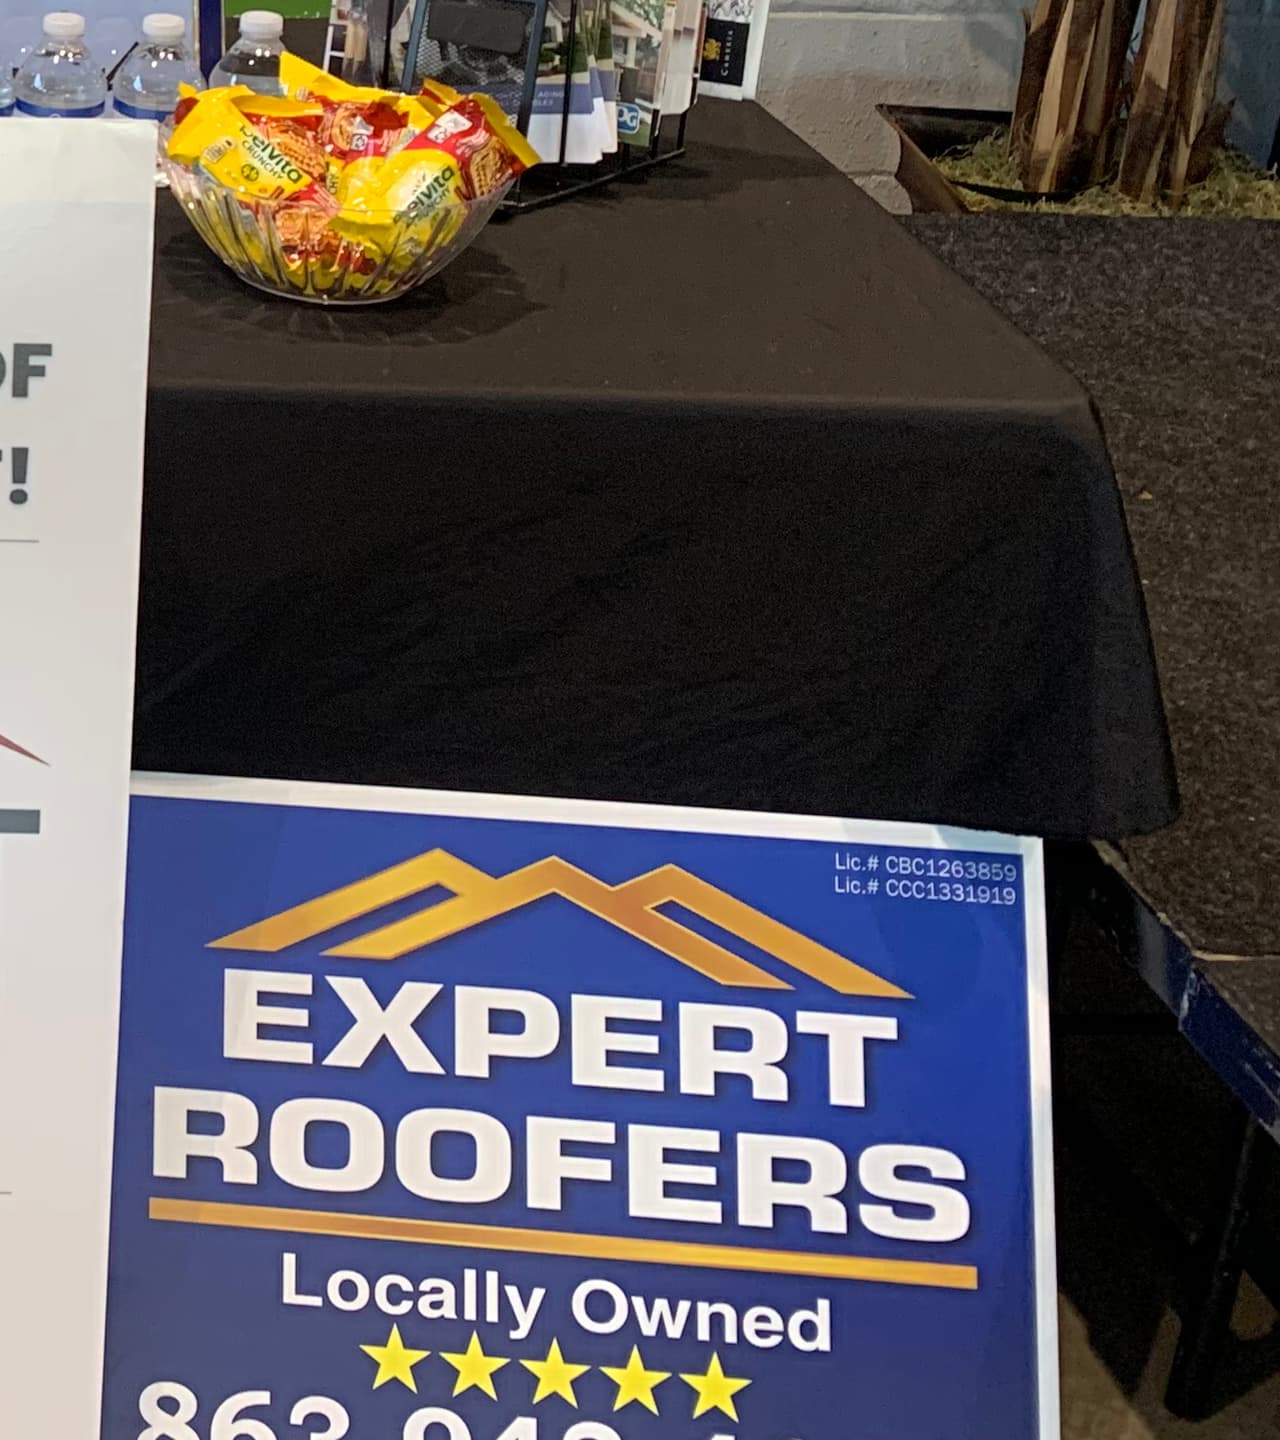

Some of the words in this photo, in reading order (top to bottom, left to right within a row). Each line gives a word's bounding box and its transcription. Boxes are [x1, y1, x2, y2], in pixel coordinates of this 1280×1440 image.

[835, 852, 879, 871] Lic.#
[885, 856, 1016, 882] CBC1263859
[835, 876, 879, 894] Lic.#
[886, 879, 1016, 905] CCC1331919
[223, 968, 898, 1107] EXPERT
[153, 1086, 970, 1242] ROOFERS
[283, 1252, 546, 1339] Locally
[572, 1279, 831, 1351] Owned
